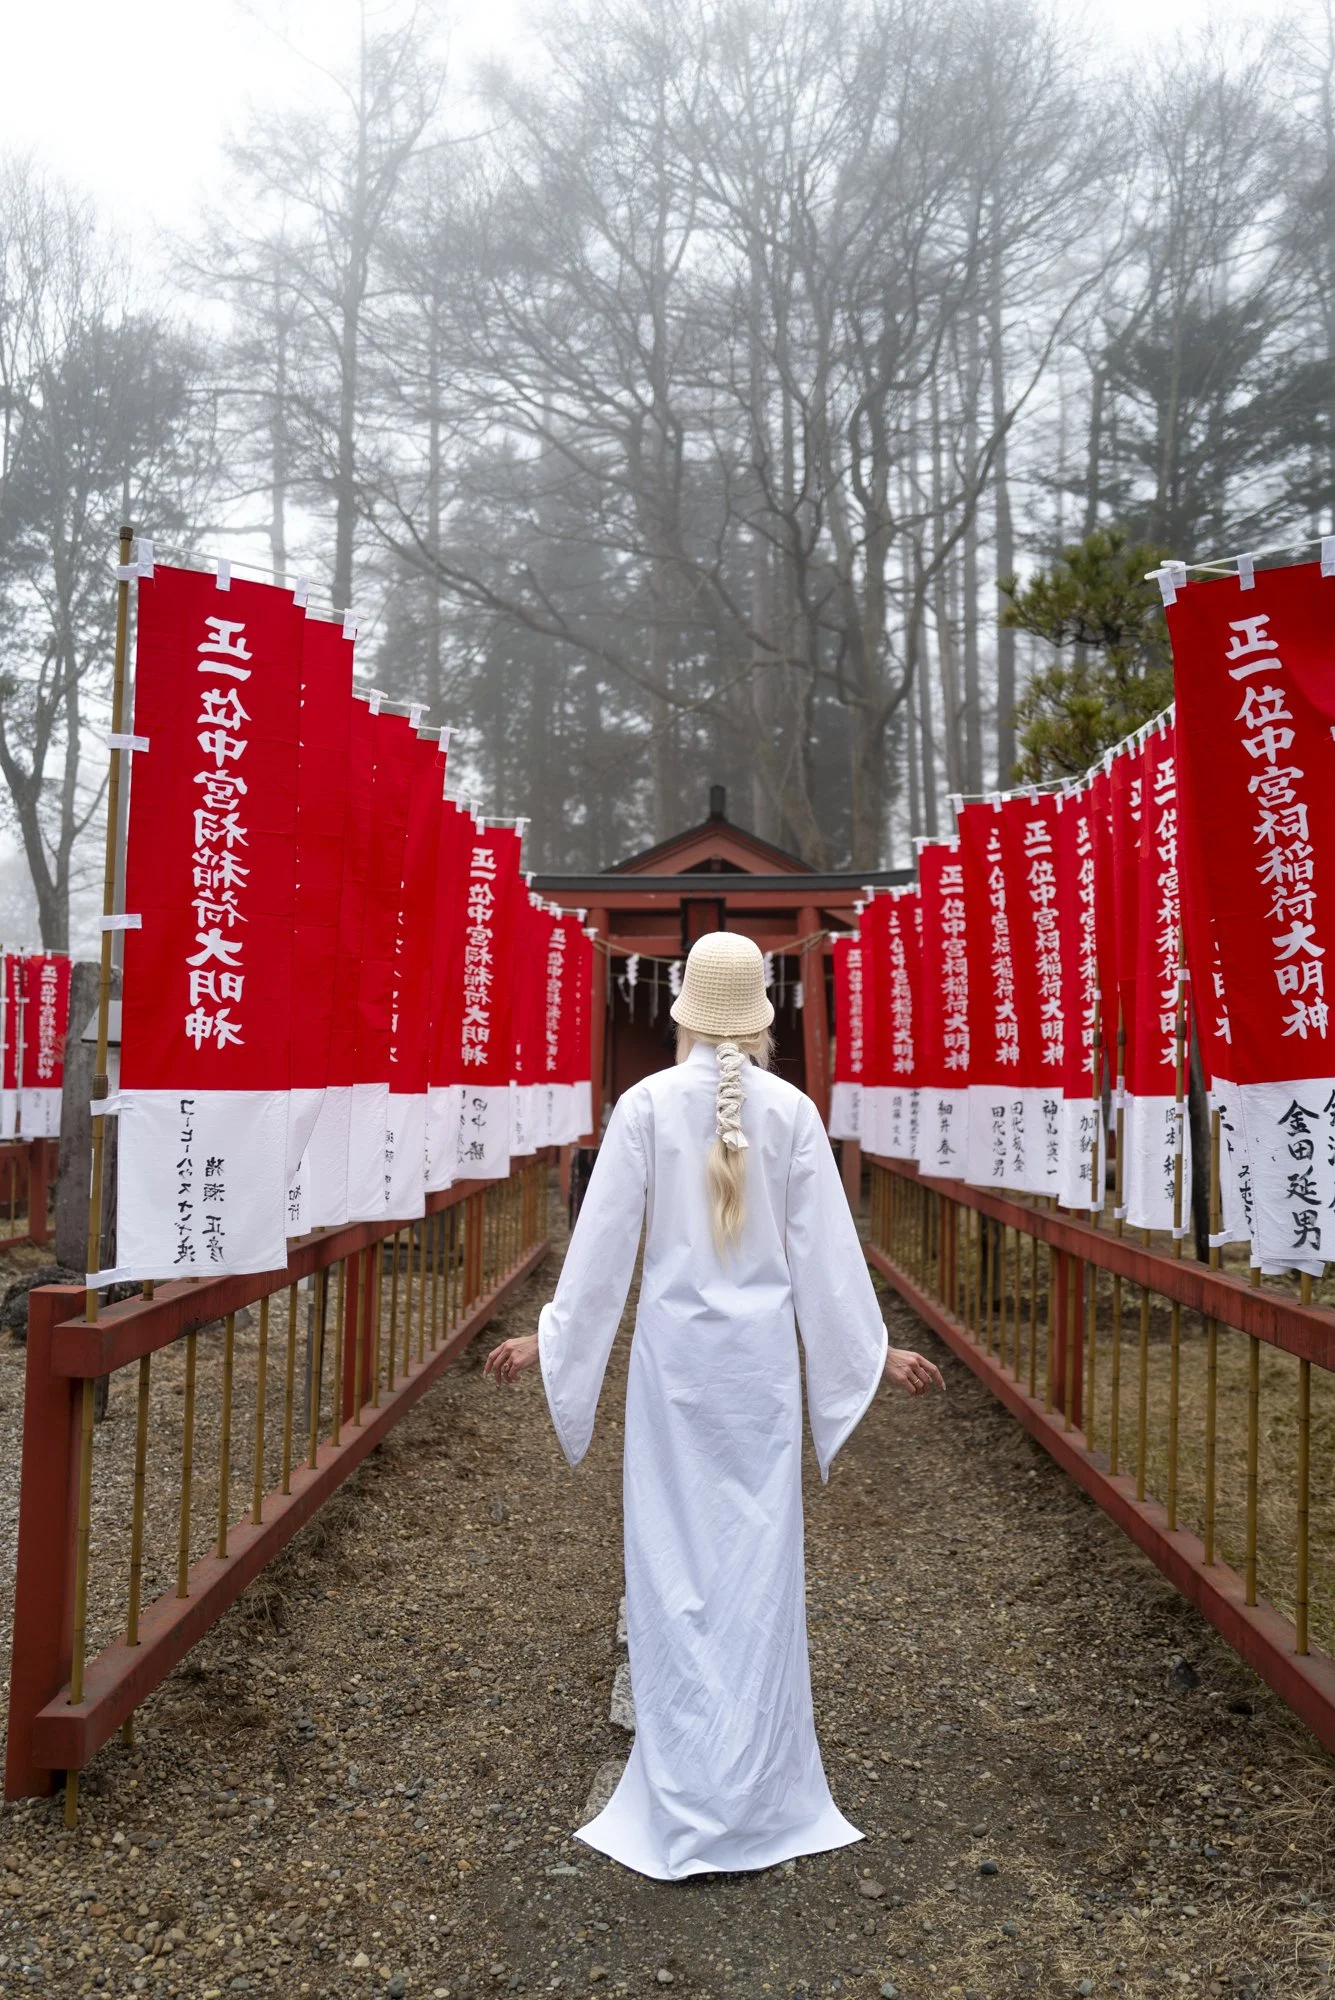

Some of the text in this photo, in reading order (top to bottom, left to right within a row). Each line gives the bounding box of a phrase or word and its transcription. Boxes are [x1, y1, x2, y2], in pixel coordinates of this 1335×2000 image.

[1225, 613, 1329, 1040] 正一位中宮祠稲荷大明神
[939, 865, 969, 1071] 正一位中宮祠稲荷大明神
[1023, 820, 1064, 1066] 正一位中宮祠稲荷大明神
[1277, 1099, 1323, 1252] 金田延男
